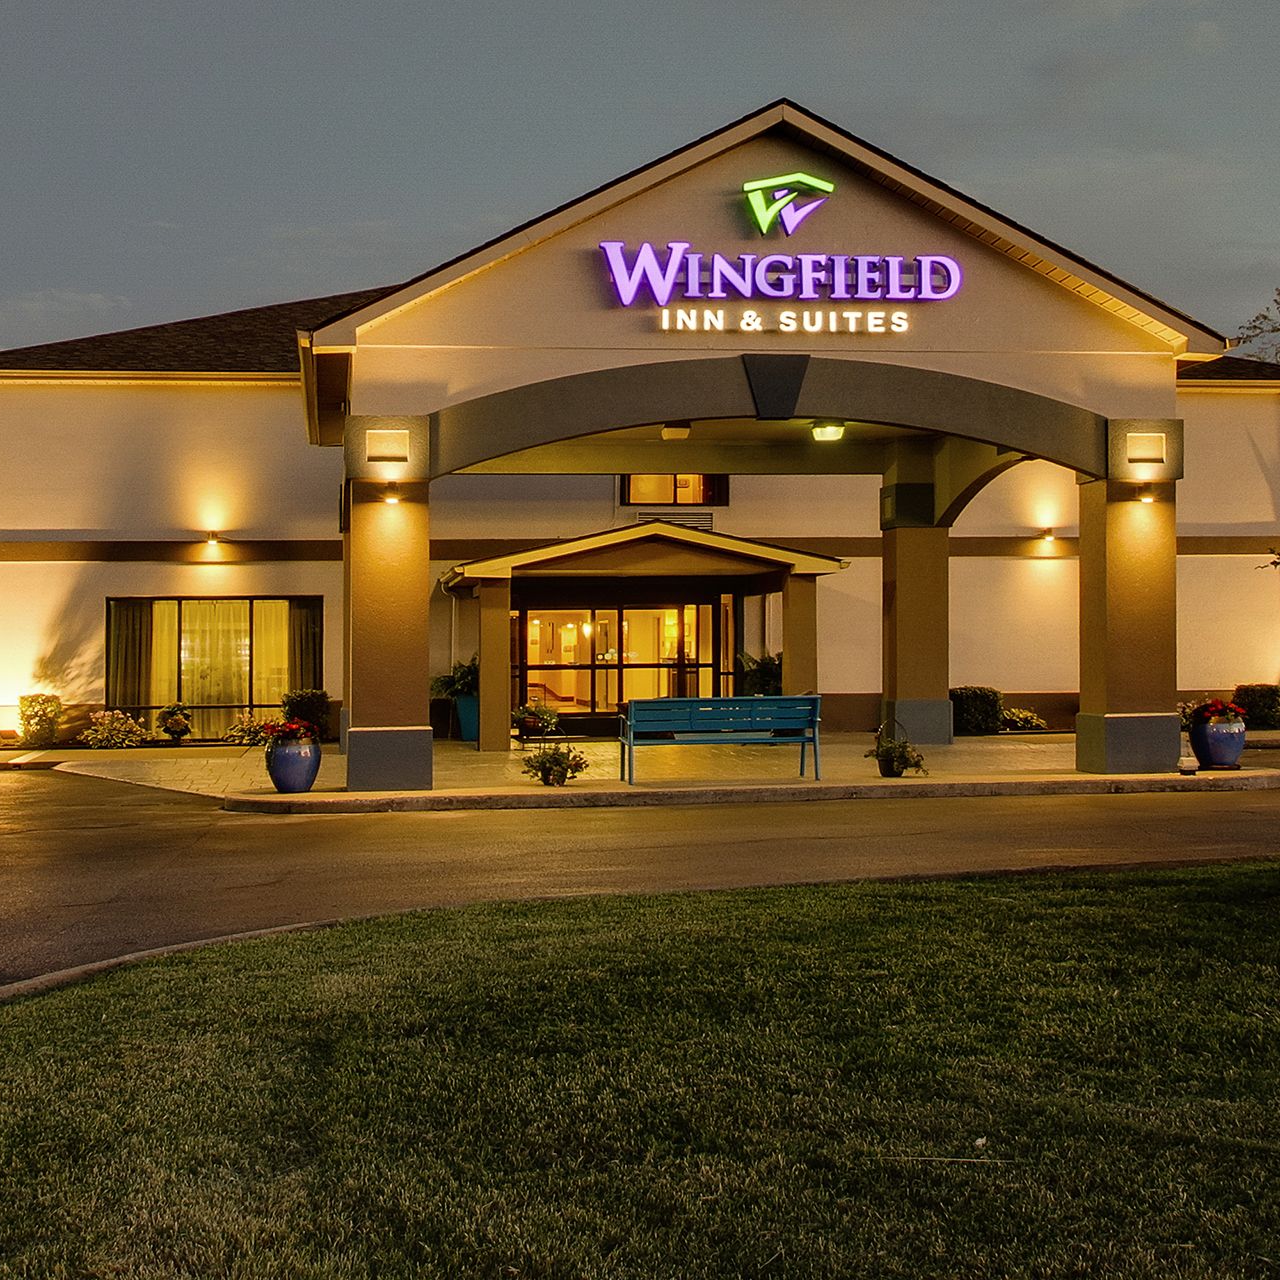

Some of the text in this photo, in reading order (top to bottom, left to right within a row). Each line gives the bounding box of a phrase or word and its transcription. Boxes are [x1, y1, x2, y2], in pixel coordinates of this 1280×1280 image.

[599, 241, 962, 307] WINGFIELD
[662, 309, 910, 333] INN & SUITES
